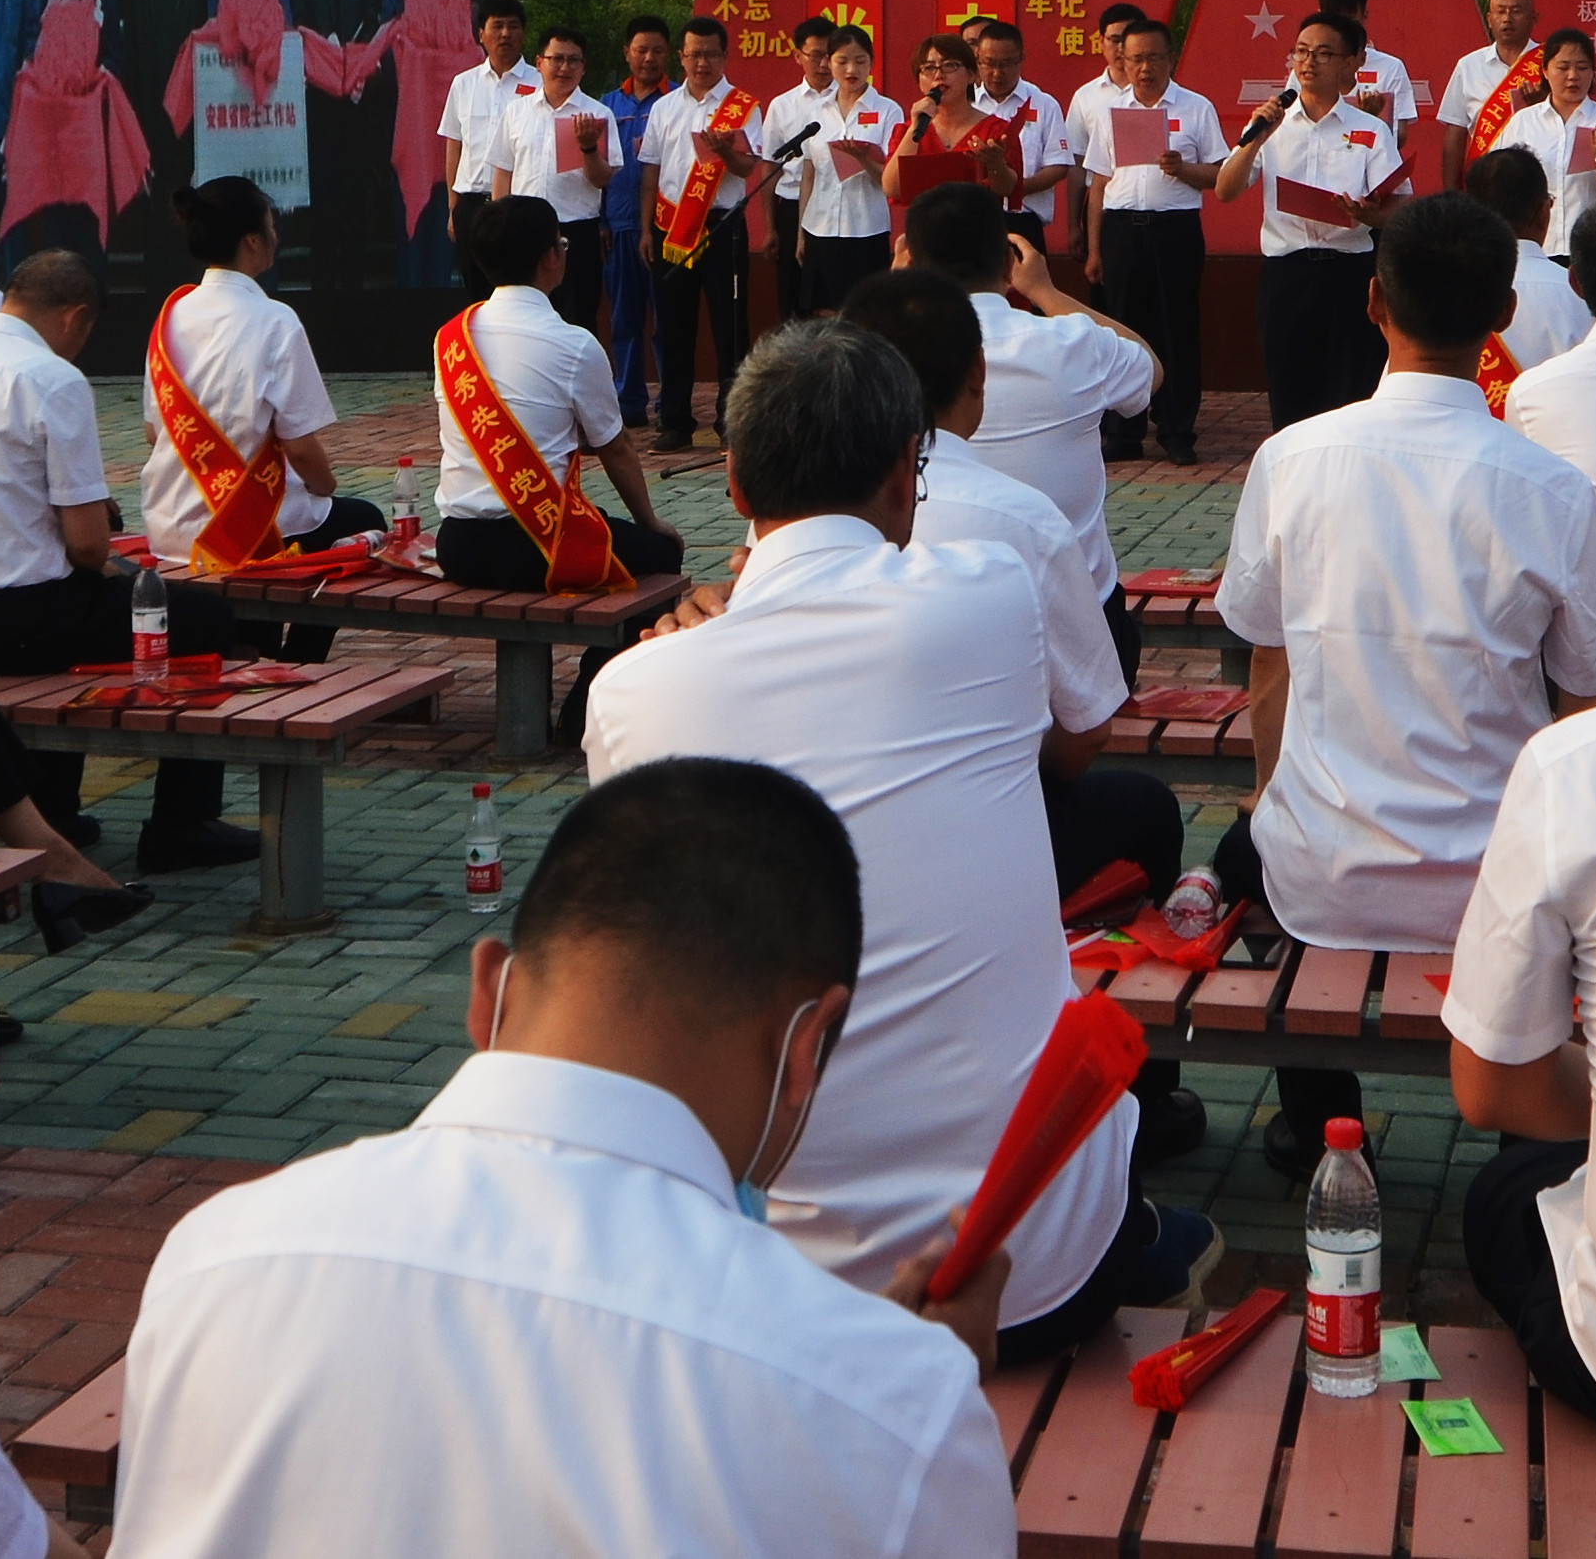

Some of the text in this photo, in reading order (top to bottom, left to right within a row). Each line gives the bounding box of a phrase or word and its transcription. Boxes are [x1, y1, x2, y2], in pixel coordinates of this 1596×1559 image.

[739, 29, 797, 59] 初心
[442, 339, 562, 536] 优秀共产党员
